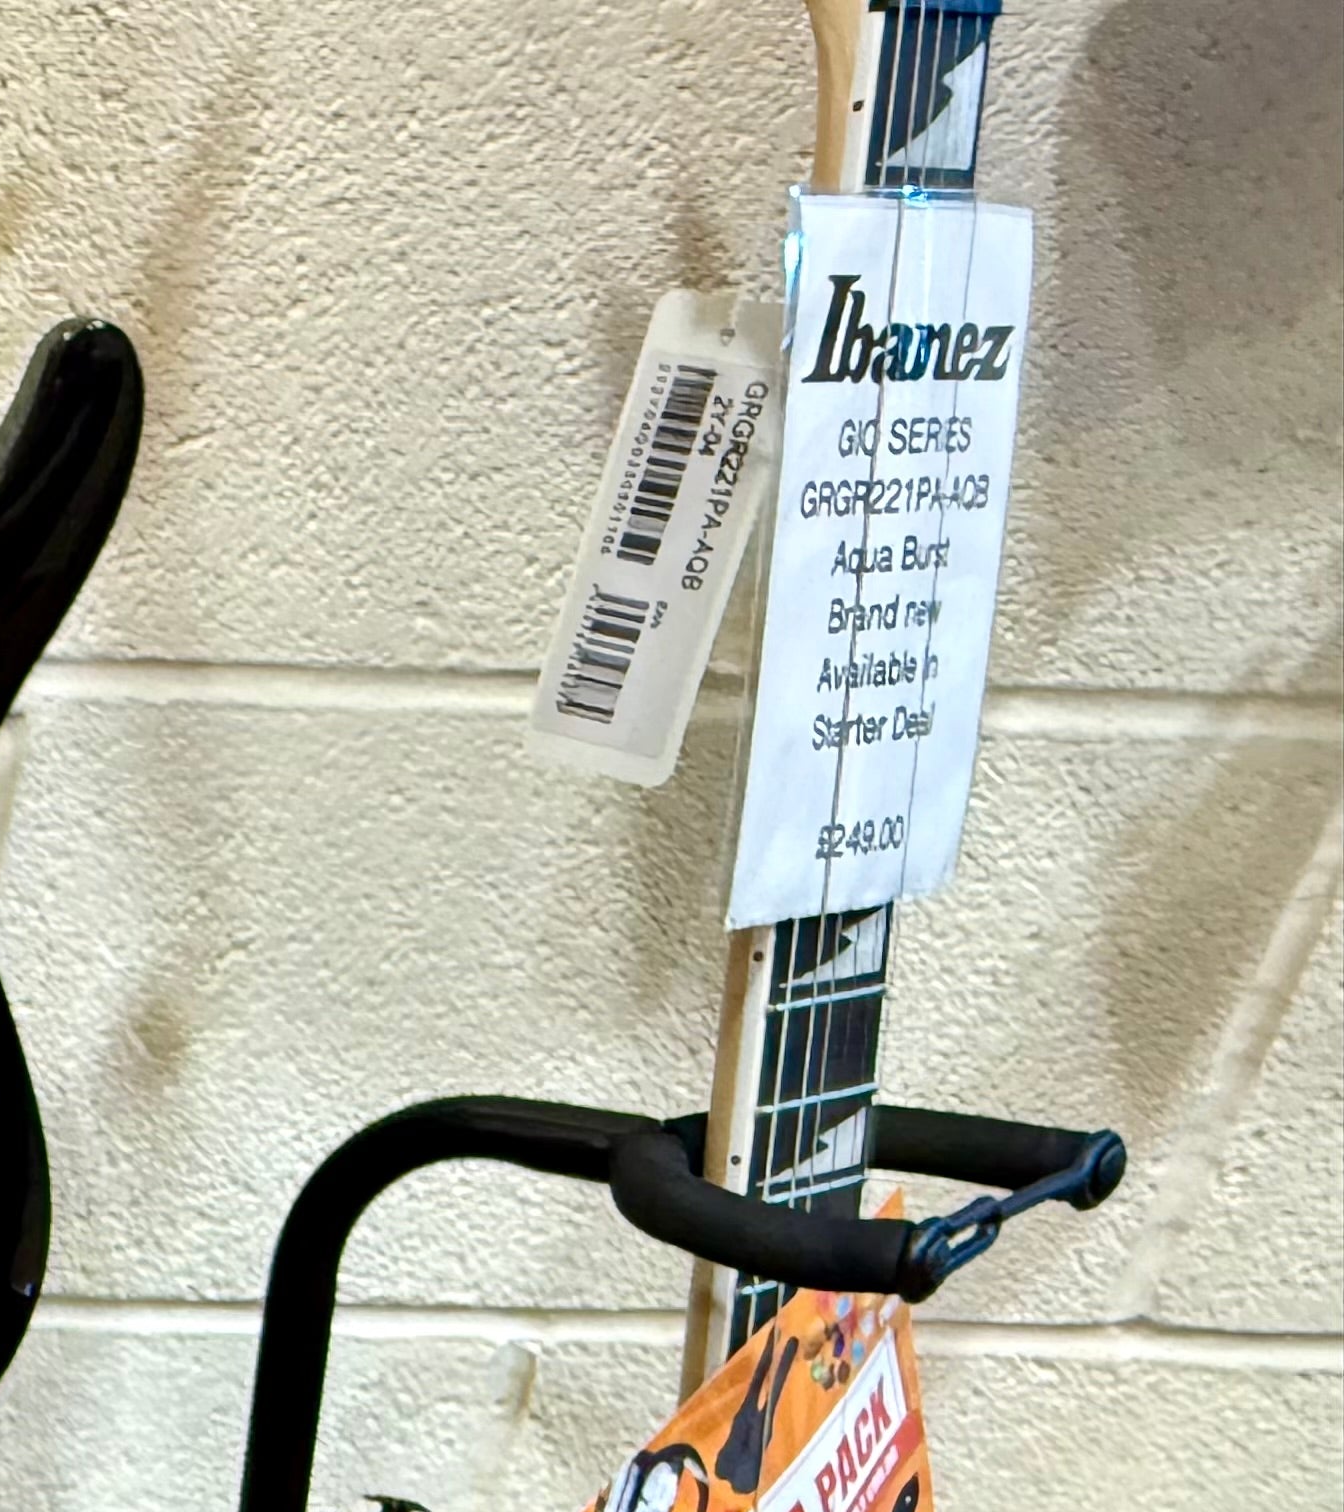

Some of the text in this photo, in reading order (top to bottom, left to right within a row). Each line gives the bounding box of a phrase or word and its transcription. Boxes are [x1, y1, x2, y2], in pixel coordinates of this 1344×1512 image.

[801, 274, 1015, 383] Ibanez
[838, 416, 972, 458] GIO SERES
[681, 381, 769, 591] GRGR221PA-AQB
[830, 535, 950, 578] Aqua Burst
[828, 594, 943, 634] Brand new
[816, 650, 918, 693] Available
[812, 701, 936, 751] Starter Deal
[815, 814, 904, 860] $249.00
